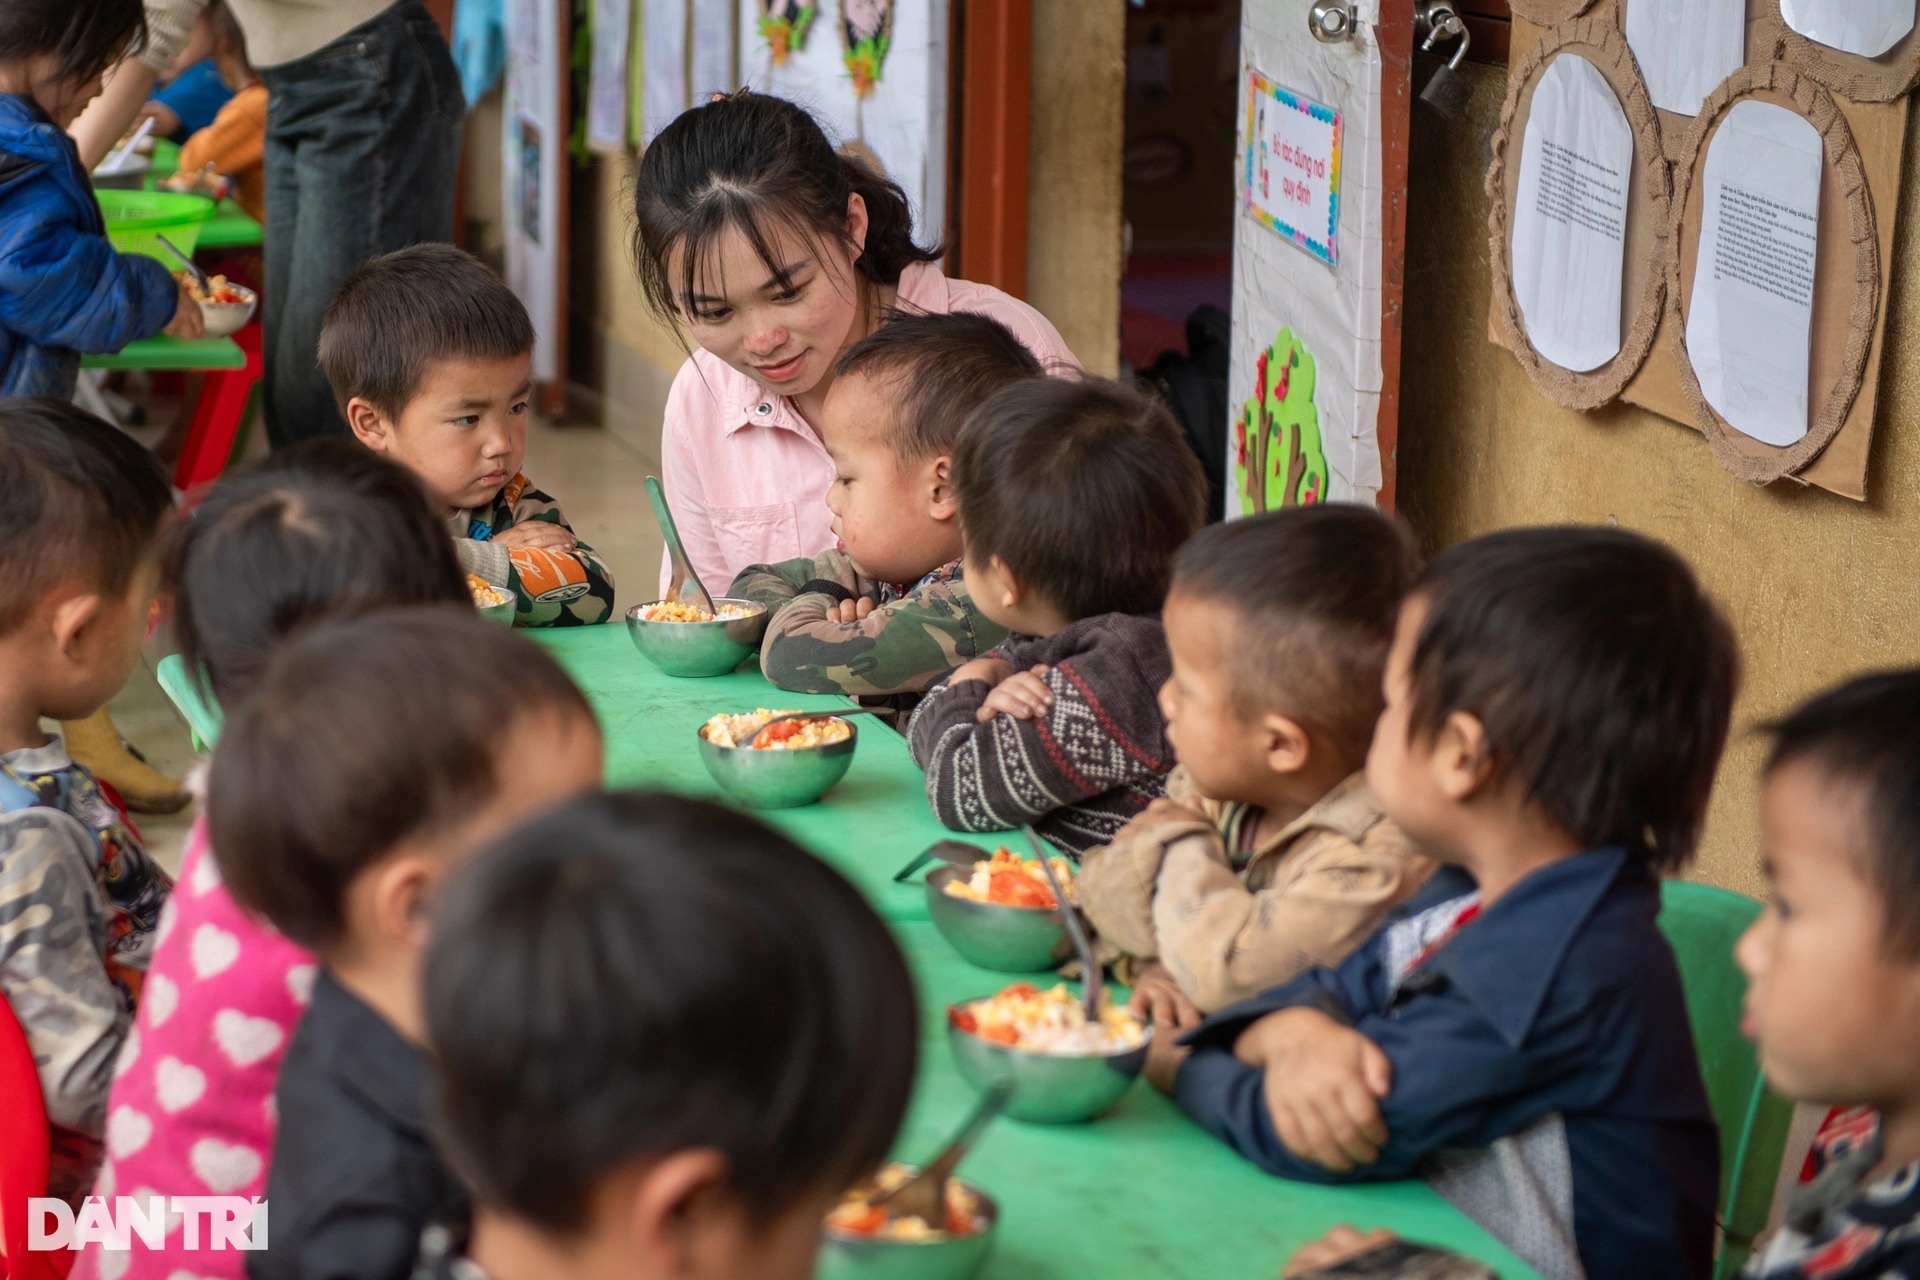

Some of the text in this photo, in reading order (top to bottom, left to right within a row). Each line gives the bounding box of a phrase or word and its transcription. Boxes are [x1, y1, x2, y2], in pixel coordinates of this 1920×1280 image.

[1281, 139, 1293, 164] rác
[1294, 144, 1312, 178] đúng
[1283, 176, 1311, 208] quy định
